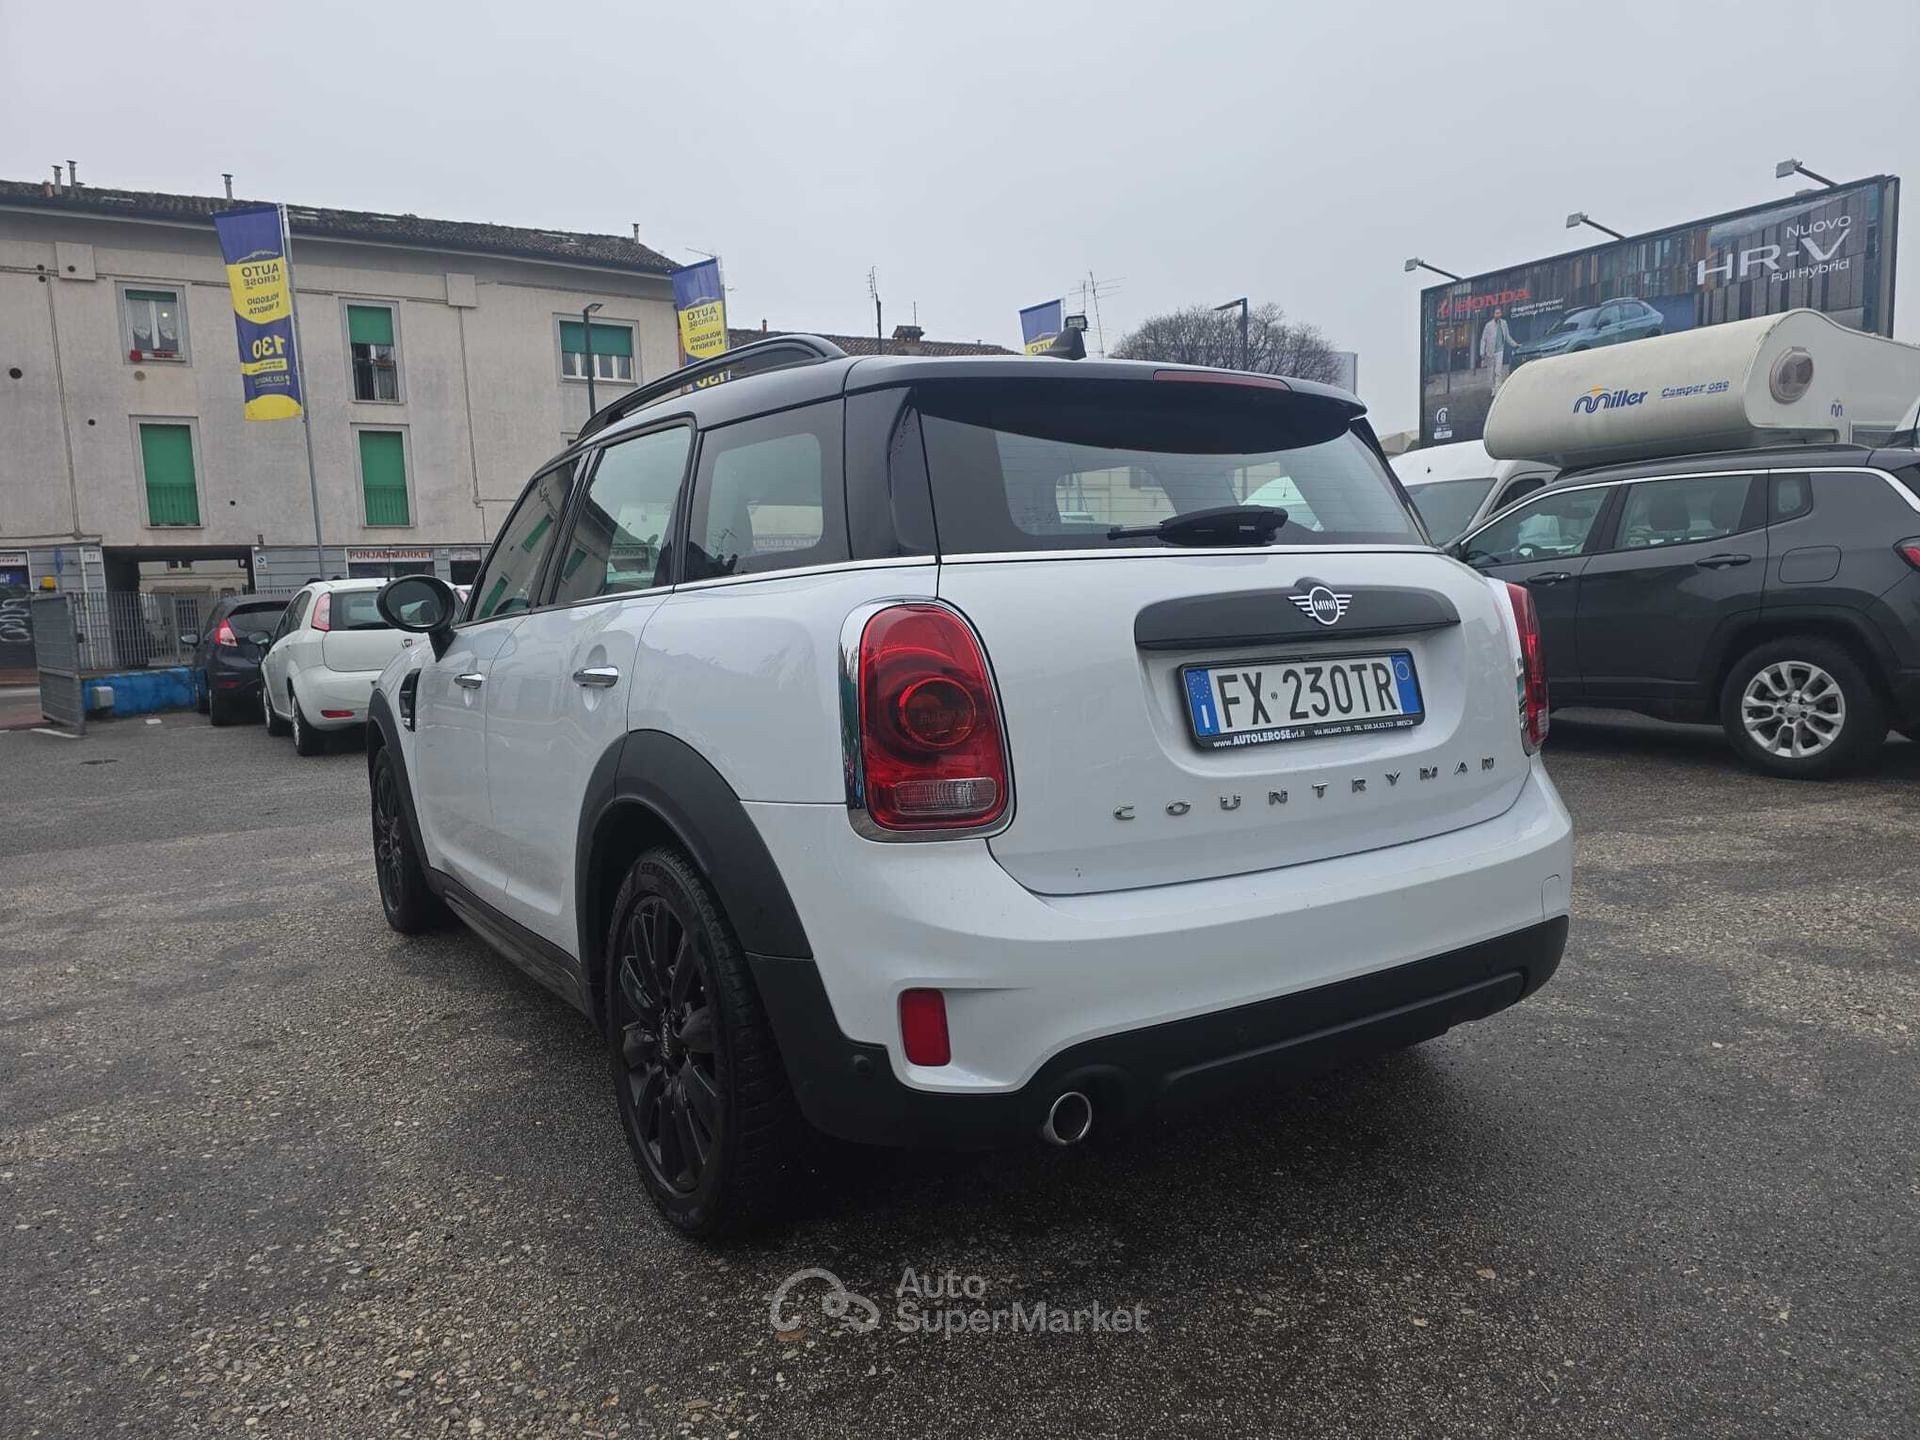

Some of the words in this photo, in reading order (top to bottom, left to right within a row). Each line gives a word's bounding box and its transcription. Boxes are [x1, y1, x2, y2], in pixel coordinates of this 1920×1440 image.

[1697, 228, 1851, 286] HR-V
[1770, 269, 1796, 284] Full
[1798, 258, 1849, 280] Hybrid
[1455, 289, 1530, 311] HONDA
[391, 551, 432, 559] MARKET
[1314, 599, 1336, 611] MINI
[1216, 671, 1272, 729] FX
[1282, 662, 1398, 721] 230TR
[1112, 756, 1495, 821] COUNTRYMAN
